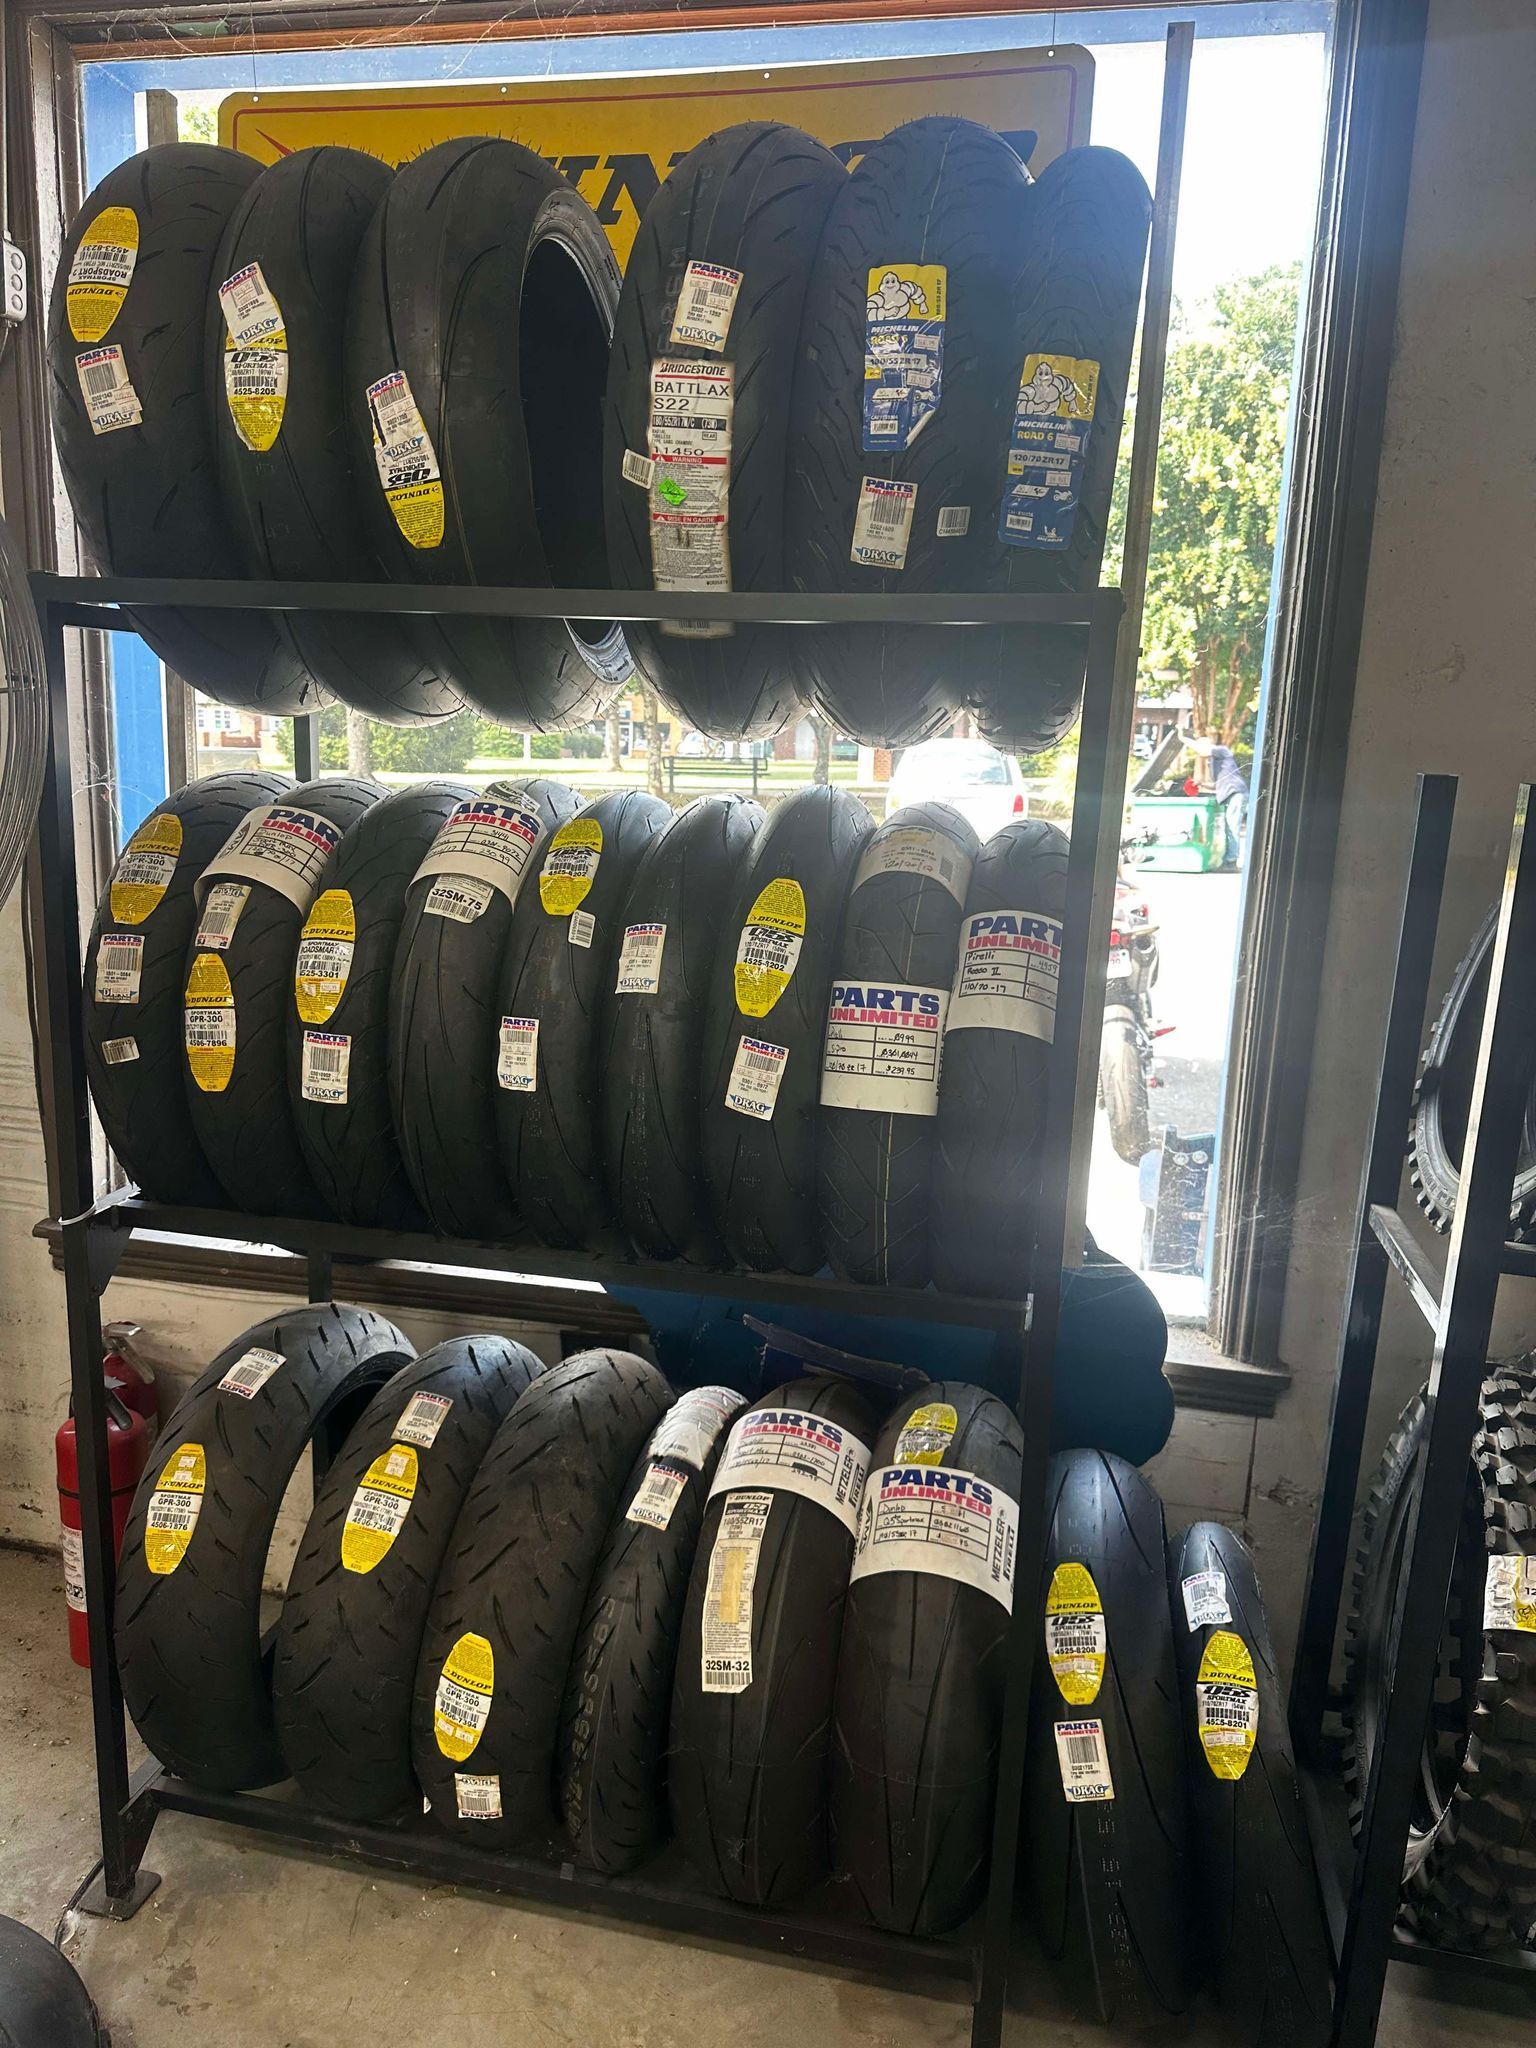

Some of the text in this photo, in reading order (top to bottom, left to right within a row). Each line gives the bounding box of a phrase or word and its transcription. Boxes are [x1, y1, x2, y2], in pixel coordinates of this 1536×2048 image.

[79, 267, 128, 279] ROADSPORT
[690, 269, 738, 285] UNLIMITED
[691, 262, 740, 279] PARTS
[78, 274, 117, 282] SPORTMAX
[68, 289, 114, 297] DUNLOP
[241, 317, 275, 341] DRAG
[681, 325, 717, 343] DRAG
[870, 324, 920, 333] MICHELIN
[77, 347, 118, 363] PARTS
[78, 354, 120, 368] UNLIMITED
[659, 363, 727, 377] BRIDGESTONE
[368, 373, 403, 396] PARTS
[654, 381, 730, 398] BATTLAX
[234, 387, 276, 396] 4525-8205
[653, 398, 690, 412] S22
[1017, 420, 1068, 430] MICHELIN
[1017, 431, 1054, 442] ROAD 6
[389, 439, 419, 458] DRAG
[654, 446, 705, 456] 11450
[672, 456, 703, 464] WARNING
[388, 462, 426, 476] SPORTMAX
[865, 478, 914, 493] PARTS
[390, 488, 431, 503] DUNLOP
[864, 487, 913, 499] UNLIMITED
[692, 516, 716, 524] GARDE
[861, 547, 897, 562] DRAG
[136, 842, 180, 852] DUNLOP
[126, 856, 166, 867] GPR-300
[119, 877, 161, 887] 4506-7896
[431, 888, 483, 911] 32SM-75
[626, 923, 663, 933] PARTS
[756, 914, 803, 930] DUNLOP
[308, 927, 355, 937] DUNLOP
[969, 915, 1064, 948] PART
[104, 935, 144, 943] PARTS
[307, 940, 339, 948] SPORTMAX
[749, 935, 789, 949] SPORTMAX
[967, 950, 996, 962] Pirelli
[620, 977, 651, 987] DRAG
[832, 987, 939, 1014] PARTS
[189, 1015, 223, 1024] GPR-300
[503, 1018, 536, 1026] PARTS
[830, 1007, 939, 1029] UNLIMITED
[189, 1039, 228, 1048] 4506-7896
[306, 1032, 349, 1042] PARTS
[306, 1039, 348, 1047] UNLIMITED
[741, 1044, 784, 1061] UNLIMITED
[742, 1038, 786, 1055] PARTS
[503, 1073, 529, 1086] DRAG
[308, 1086, 340, 1098] DRAG
[733, 1094, 767, 1112] DRAG
[743, 1412, 843, 1444] PARTS
[399, 1428, 428, 1443] DRAG
[740, 1423, 842, 1453] UNLIMITED
[163, 1480, 204, 1490] DUNLOP
[371, 1478, 414, 1495] DUNLOP
[835, 1454, 855, 1506] METZELER
[881, 1469, 994, 1505] PARTS
[157, 1498, 191, 1508] GPR-300
[160, 1493, 192, 1501] SPORTMAX
[363, 1496, 399, 1511] GPR-300
[366, 1491, 400, 1503] SPORTMAX
[734, 1494, 773, 1502] DUNLOP
[879, 1484, 993, 1517] UNLIMITED
[636, 1507, 663, 1523] DRAG
[992, 1518, 1006, 1584] METZELER
[1055, 1602, 1099, 1610] DUNLOP
[705, 1659, 751, 1672] 32SM-32
[450, 1671, 492, 1690] DUNLOP
[1208, 1672, 1254, 1683] DUNLOP
[445, 1688, 480, 1707] GPR-300
[447, 1683, 480, 1700] SPORTMAX
[1206, 1695, 1246, 1704] SPORTMAX
[1057, 1722, 1099, 1731] PARTS
[1058, 1729, 1100, 1737] UNLIMITED
[1072, 1784, 1105, 1796] DRAG
